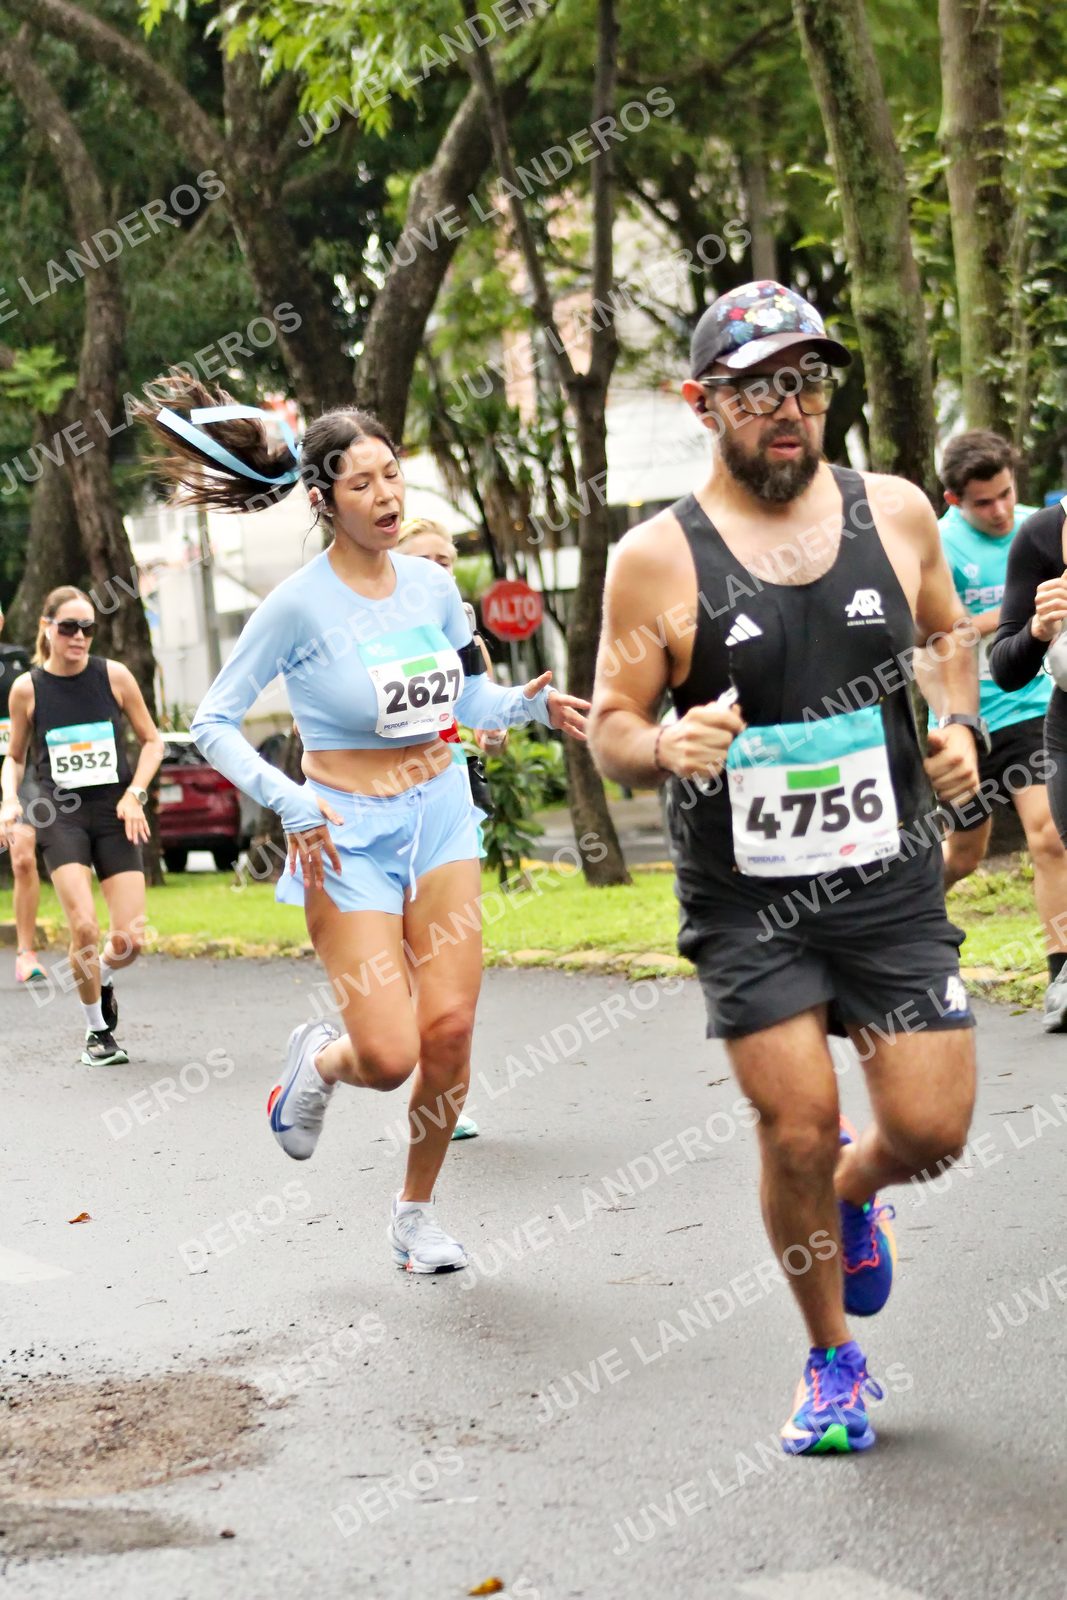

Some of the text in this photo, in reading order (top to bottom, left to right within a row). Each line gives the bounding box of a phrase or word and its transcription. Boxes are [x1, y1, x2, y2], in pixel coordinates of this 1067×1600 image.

[487, 594, 537, 623] ALTO
[383, 669, 460, 714] 2627
[56, 751, 112, 773] 5932
[746, 778, 883, 840] 4756
